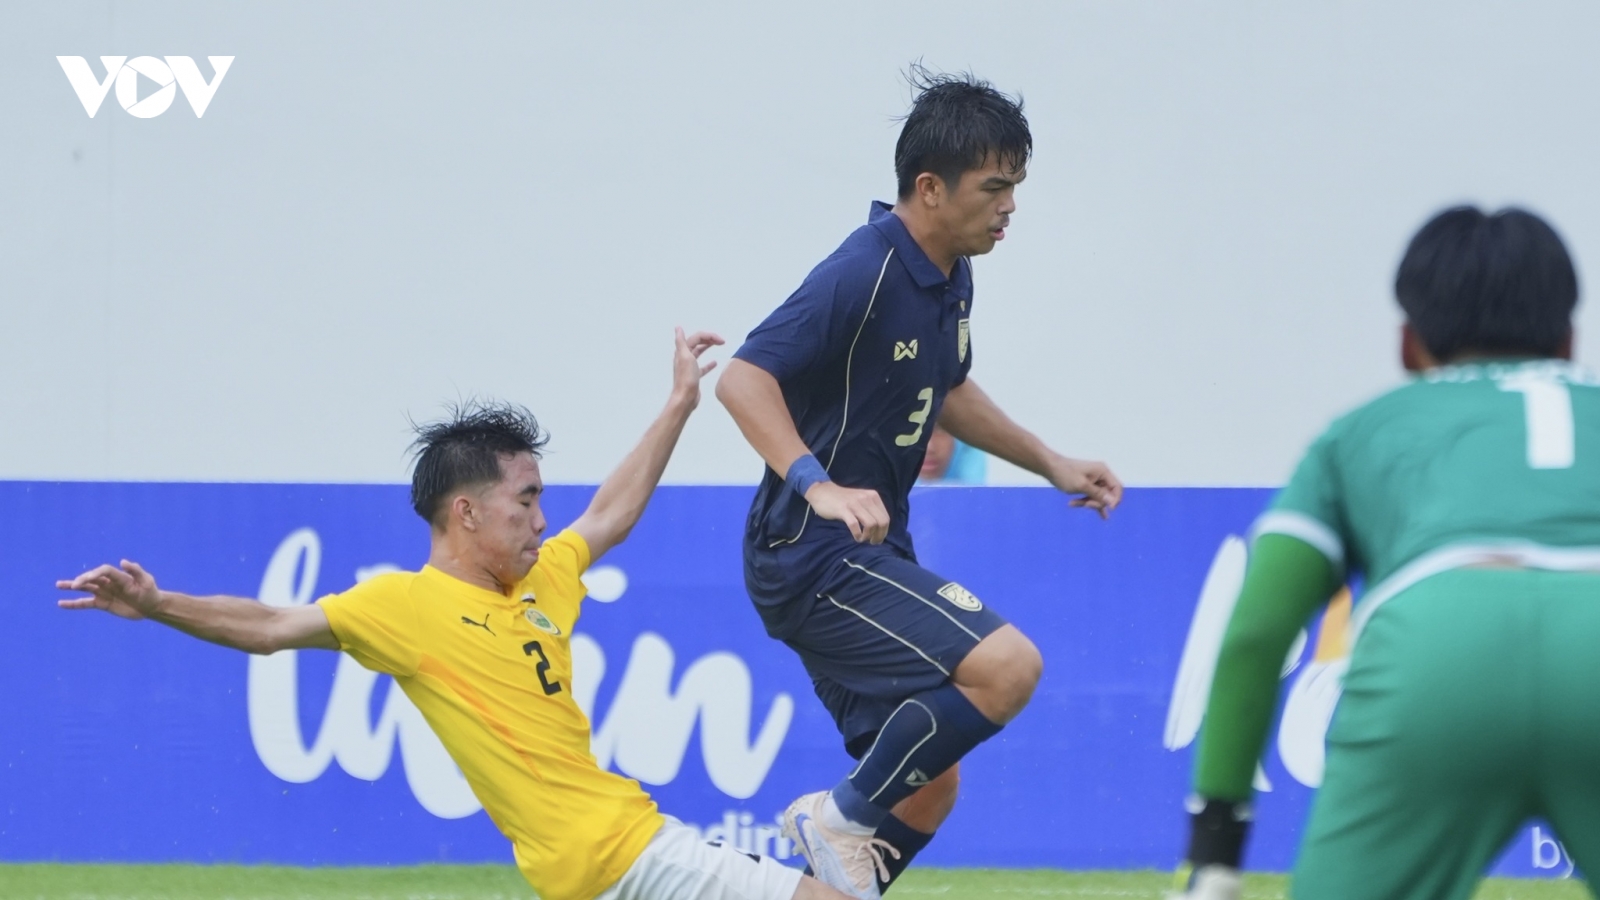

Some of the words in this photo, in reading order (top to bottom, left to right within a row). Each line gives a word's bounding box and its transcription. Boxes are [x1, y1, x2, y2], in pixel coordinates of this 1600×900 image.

[894, 387, 934, 447] 3
[1497, 372, 1575, 470] 1
[522, 640, 562, 696] 2
